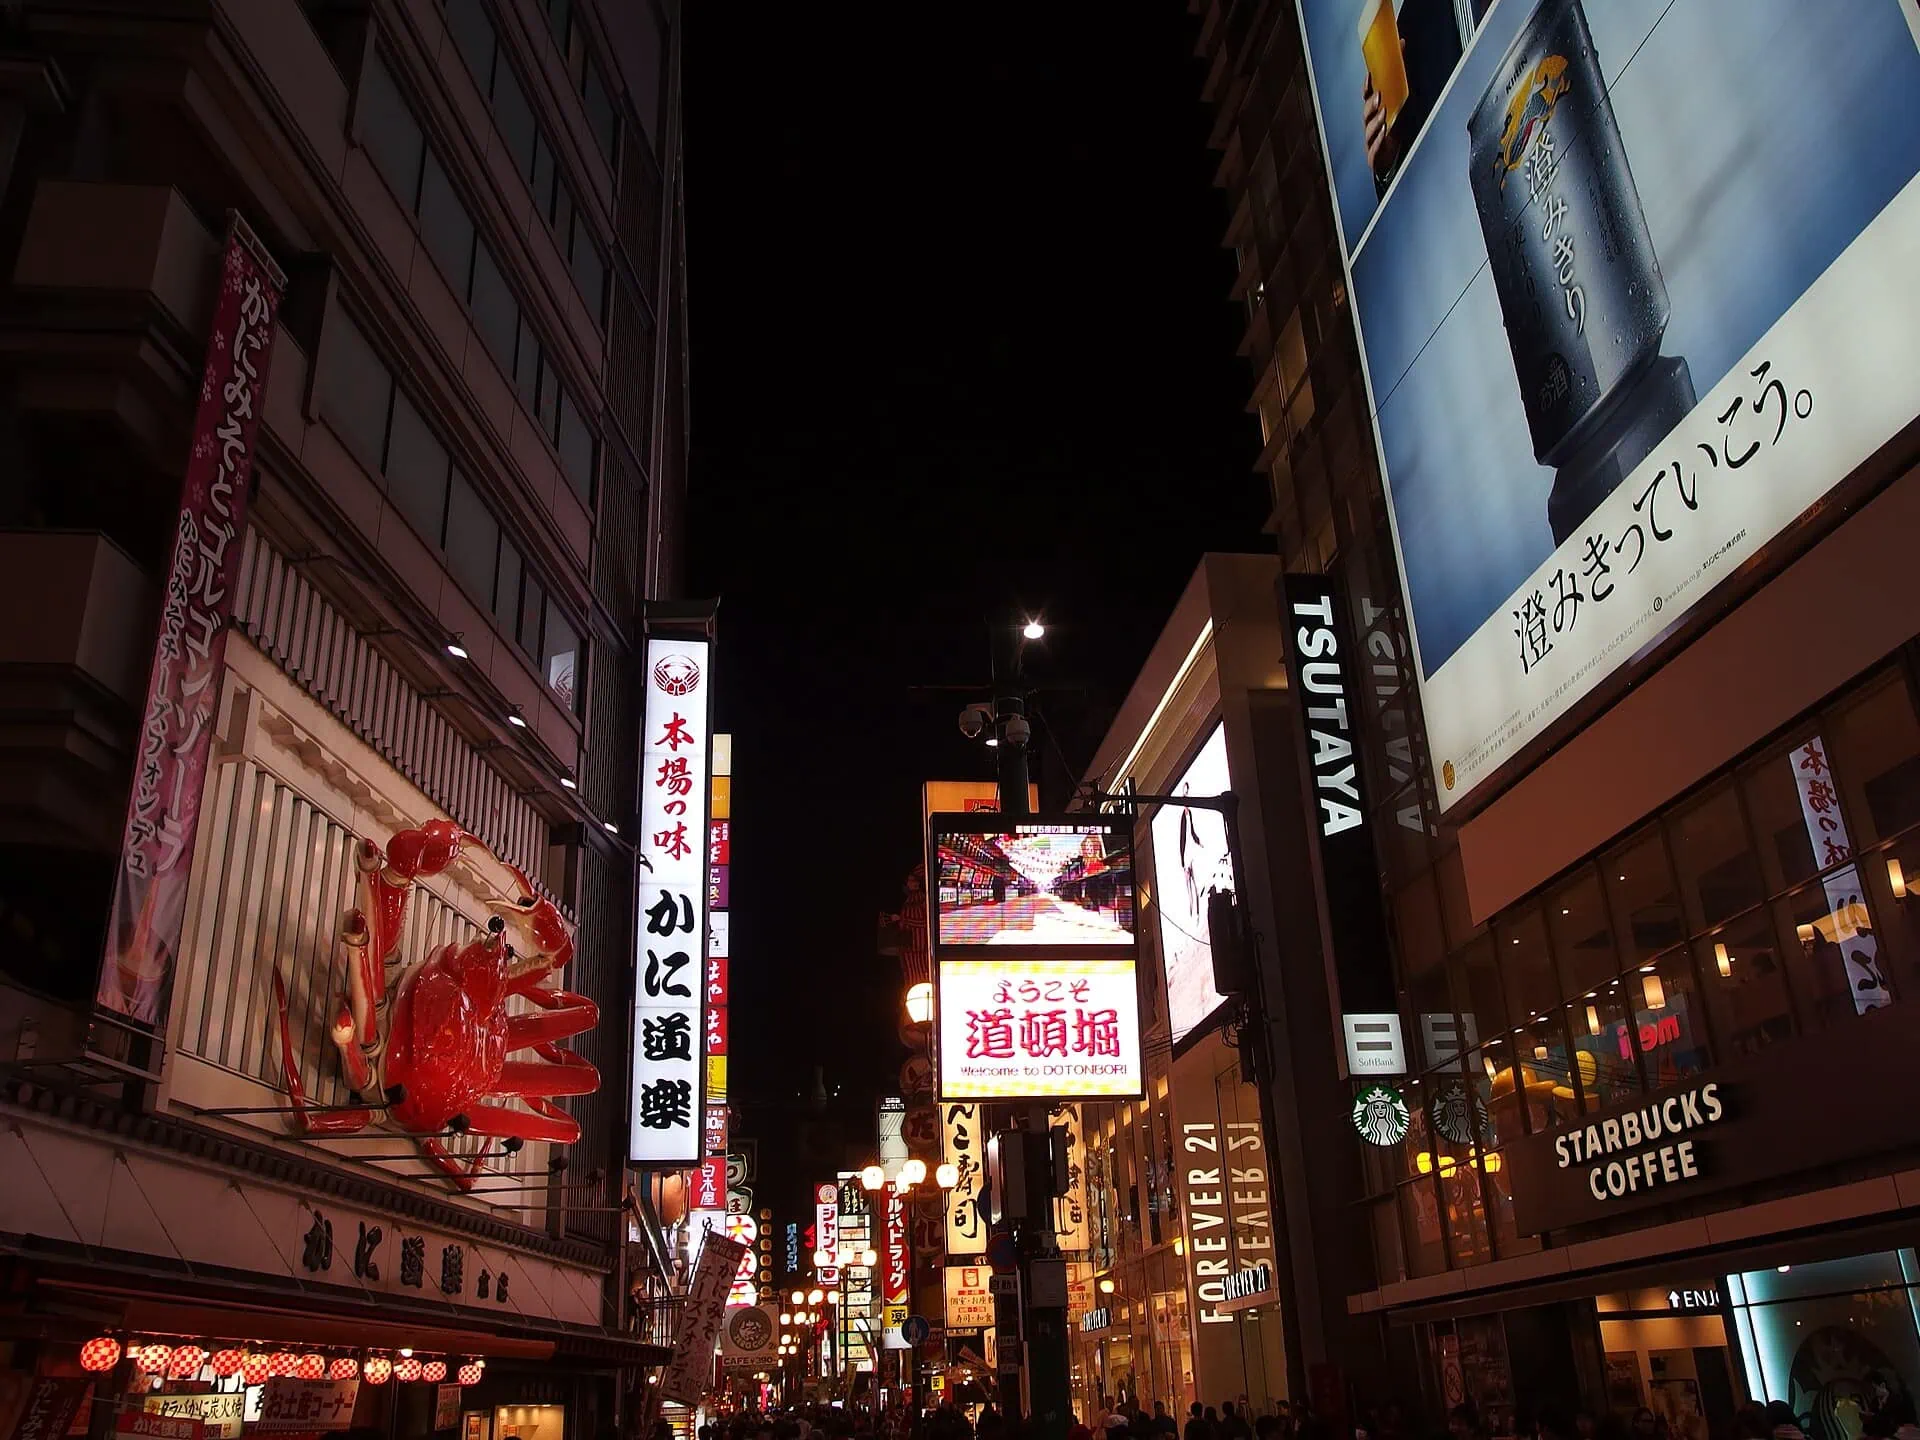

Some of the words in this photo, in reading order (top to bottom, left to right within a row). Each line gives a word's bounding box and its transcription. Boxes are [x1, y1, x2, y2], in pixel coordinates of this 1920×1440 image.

[1505, 55, 1528, 94] KIRIN
[1525, 132, 1586, 337] 澄みきり
[1512, 361, 1813, 675] 澄みきっていこう。
[154, 277, 270, 872] かにみそとゴルゴンゾーラ
[1293, 595, 1363, 837] TSUTAYA
[653, 711, 694, 861] 本場の味
[640, 889, 695, 1130] かに道楽
[993, 978, 1090, 1004] ようこそ
[965, 1007, 1120, 1059] 道頓堀
[1358, 1057, 1395, 1067] SoftBank
[960, 1065, 1019, 1076] Welcome
[1024, 1066, 1040, 1076] to
[1043, 1064, 1127, 1076] DOTONBORI
[1184, 1122, 1217, 1154] 21
[1555, 1083, 1722, 1169] STARBUCKS
[699, 1163, 718, 1206] 白木屋
[1589, 1140, 1699, 1201] COFFEE
[887, 1184, 906, 1289] ツルハドラッグ
[1188, 1168, 1234, 1323] FOREVER
[703, 1263, 735, 1341] かにみそ
[1222, 1268, 1256, 1300] FOREVER
[1255, 1266, 1266, 1292] 21
[724, 1356, 749, 1365] CAFE
[265, 1390, 354, 1419] お土産コーナー
